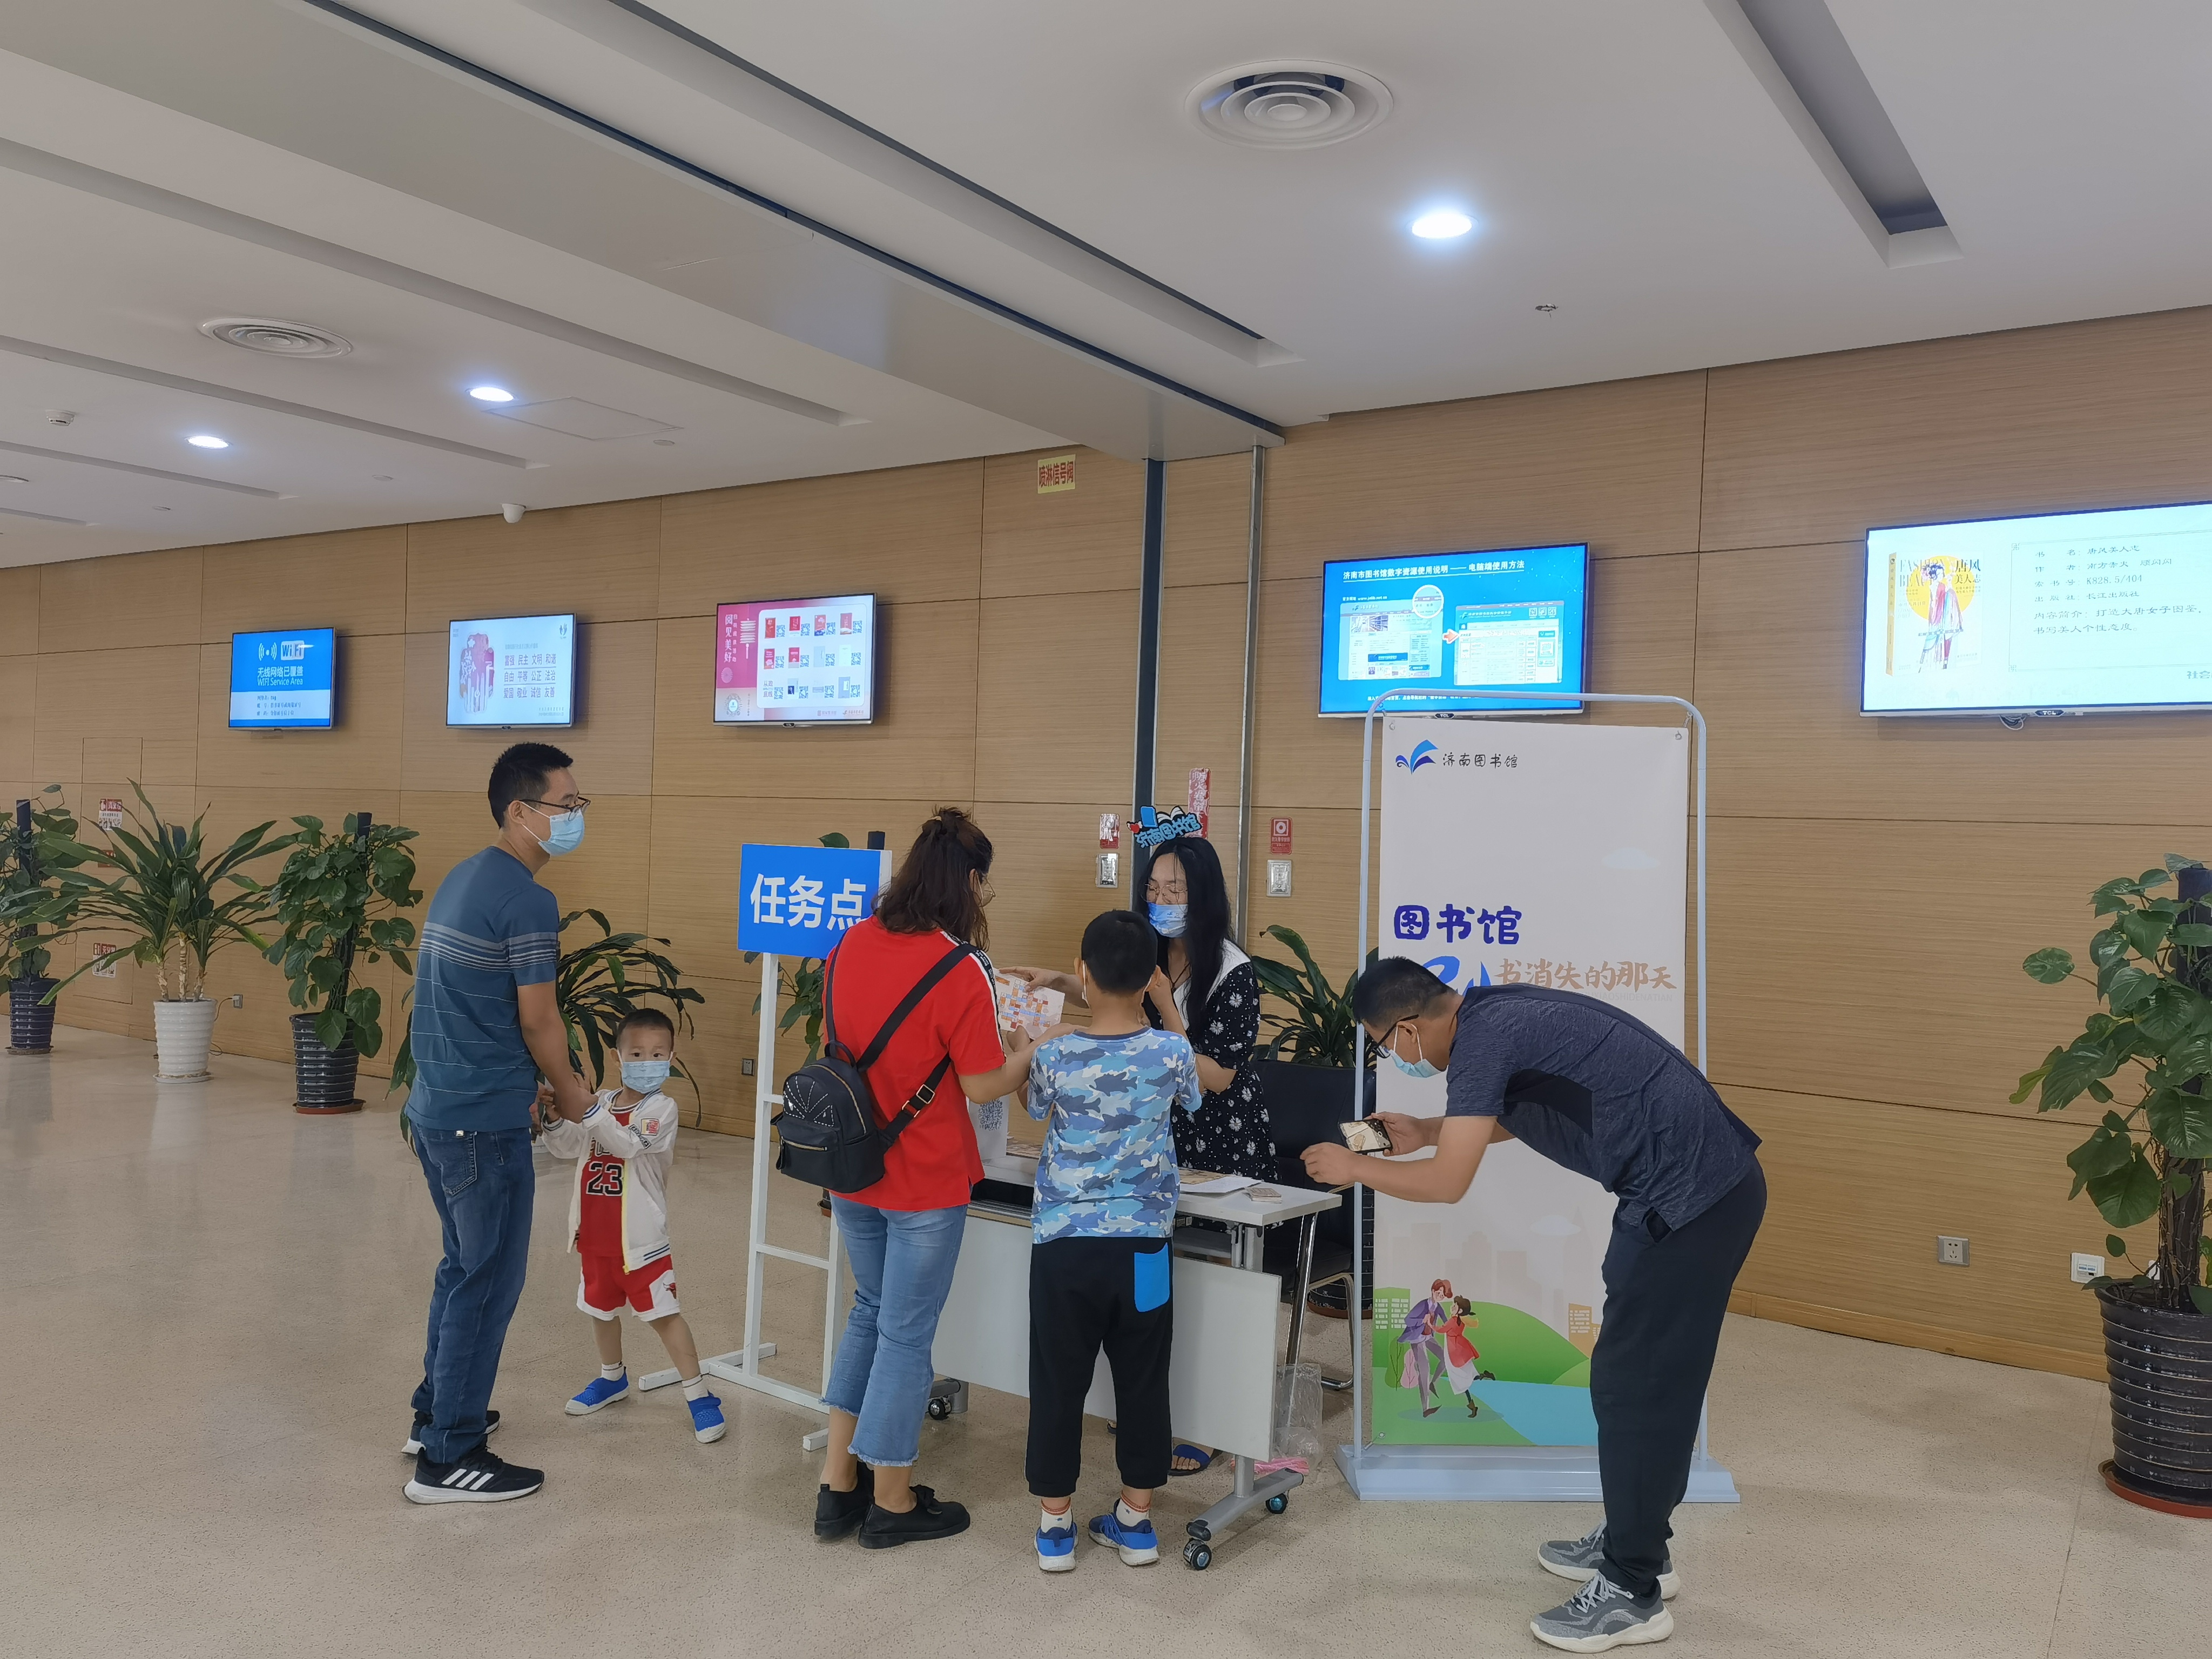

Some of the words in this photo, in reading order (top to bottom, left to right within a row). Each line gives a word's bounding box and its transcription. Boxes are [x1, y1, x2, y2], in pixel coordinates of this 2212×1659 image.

[1343, 565, 1448, 579] 济南市图书馆数字资源使用说明
[1468, 559, 1525, 571] 电脑端使用方法
[1955, 558, 1981, 572] 唐风
[1955, 574, 1981, 585] 美人志
[724, 614, 733, 663] 阅见美好
[504, 655, 515, 666] 富强
[518, 655, 528, 666] 民主
[531, 654, 542, 665] 文明
[545, 653, 556, 664] 和谐
[258, 666, 304, 678] 无线网络已覆盖
[504, 671, 515, 683] 自由
[517, 671, 528, 682] 平等
[531, 670, 542, 682] 公正
[545, 670, 556, 681] 法治
[2187, 671, 2212, 679] 社会
[270, 677, 289, 686] Service
[290, 677, 303, 685] Area
[503, 688, 514, 698] 爱国
[517, 687, 528, 698] 敬业
[530, 687, 541, 698] 诚信
[544, 686, 555, 698] 友善
[1442, 752, 1519, 768] 济南图书馆
[1135, 813, 1201, 848] 济南图书馆
[751, 873, 866, 931] 任务点
[1394, 903, 1522, 945] 图书馆
[1494, 957, 1677, 992] 书消失的那天
[586, 1161, 623, 1196] 23
